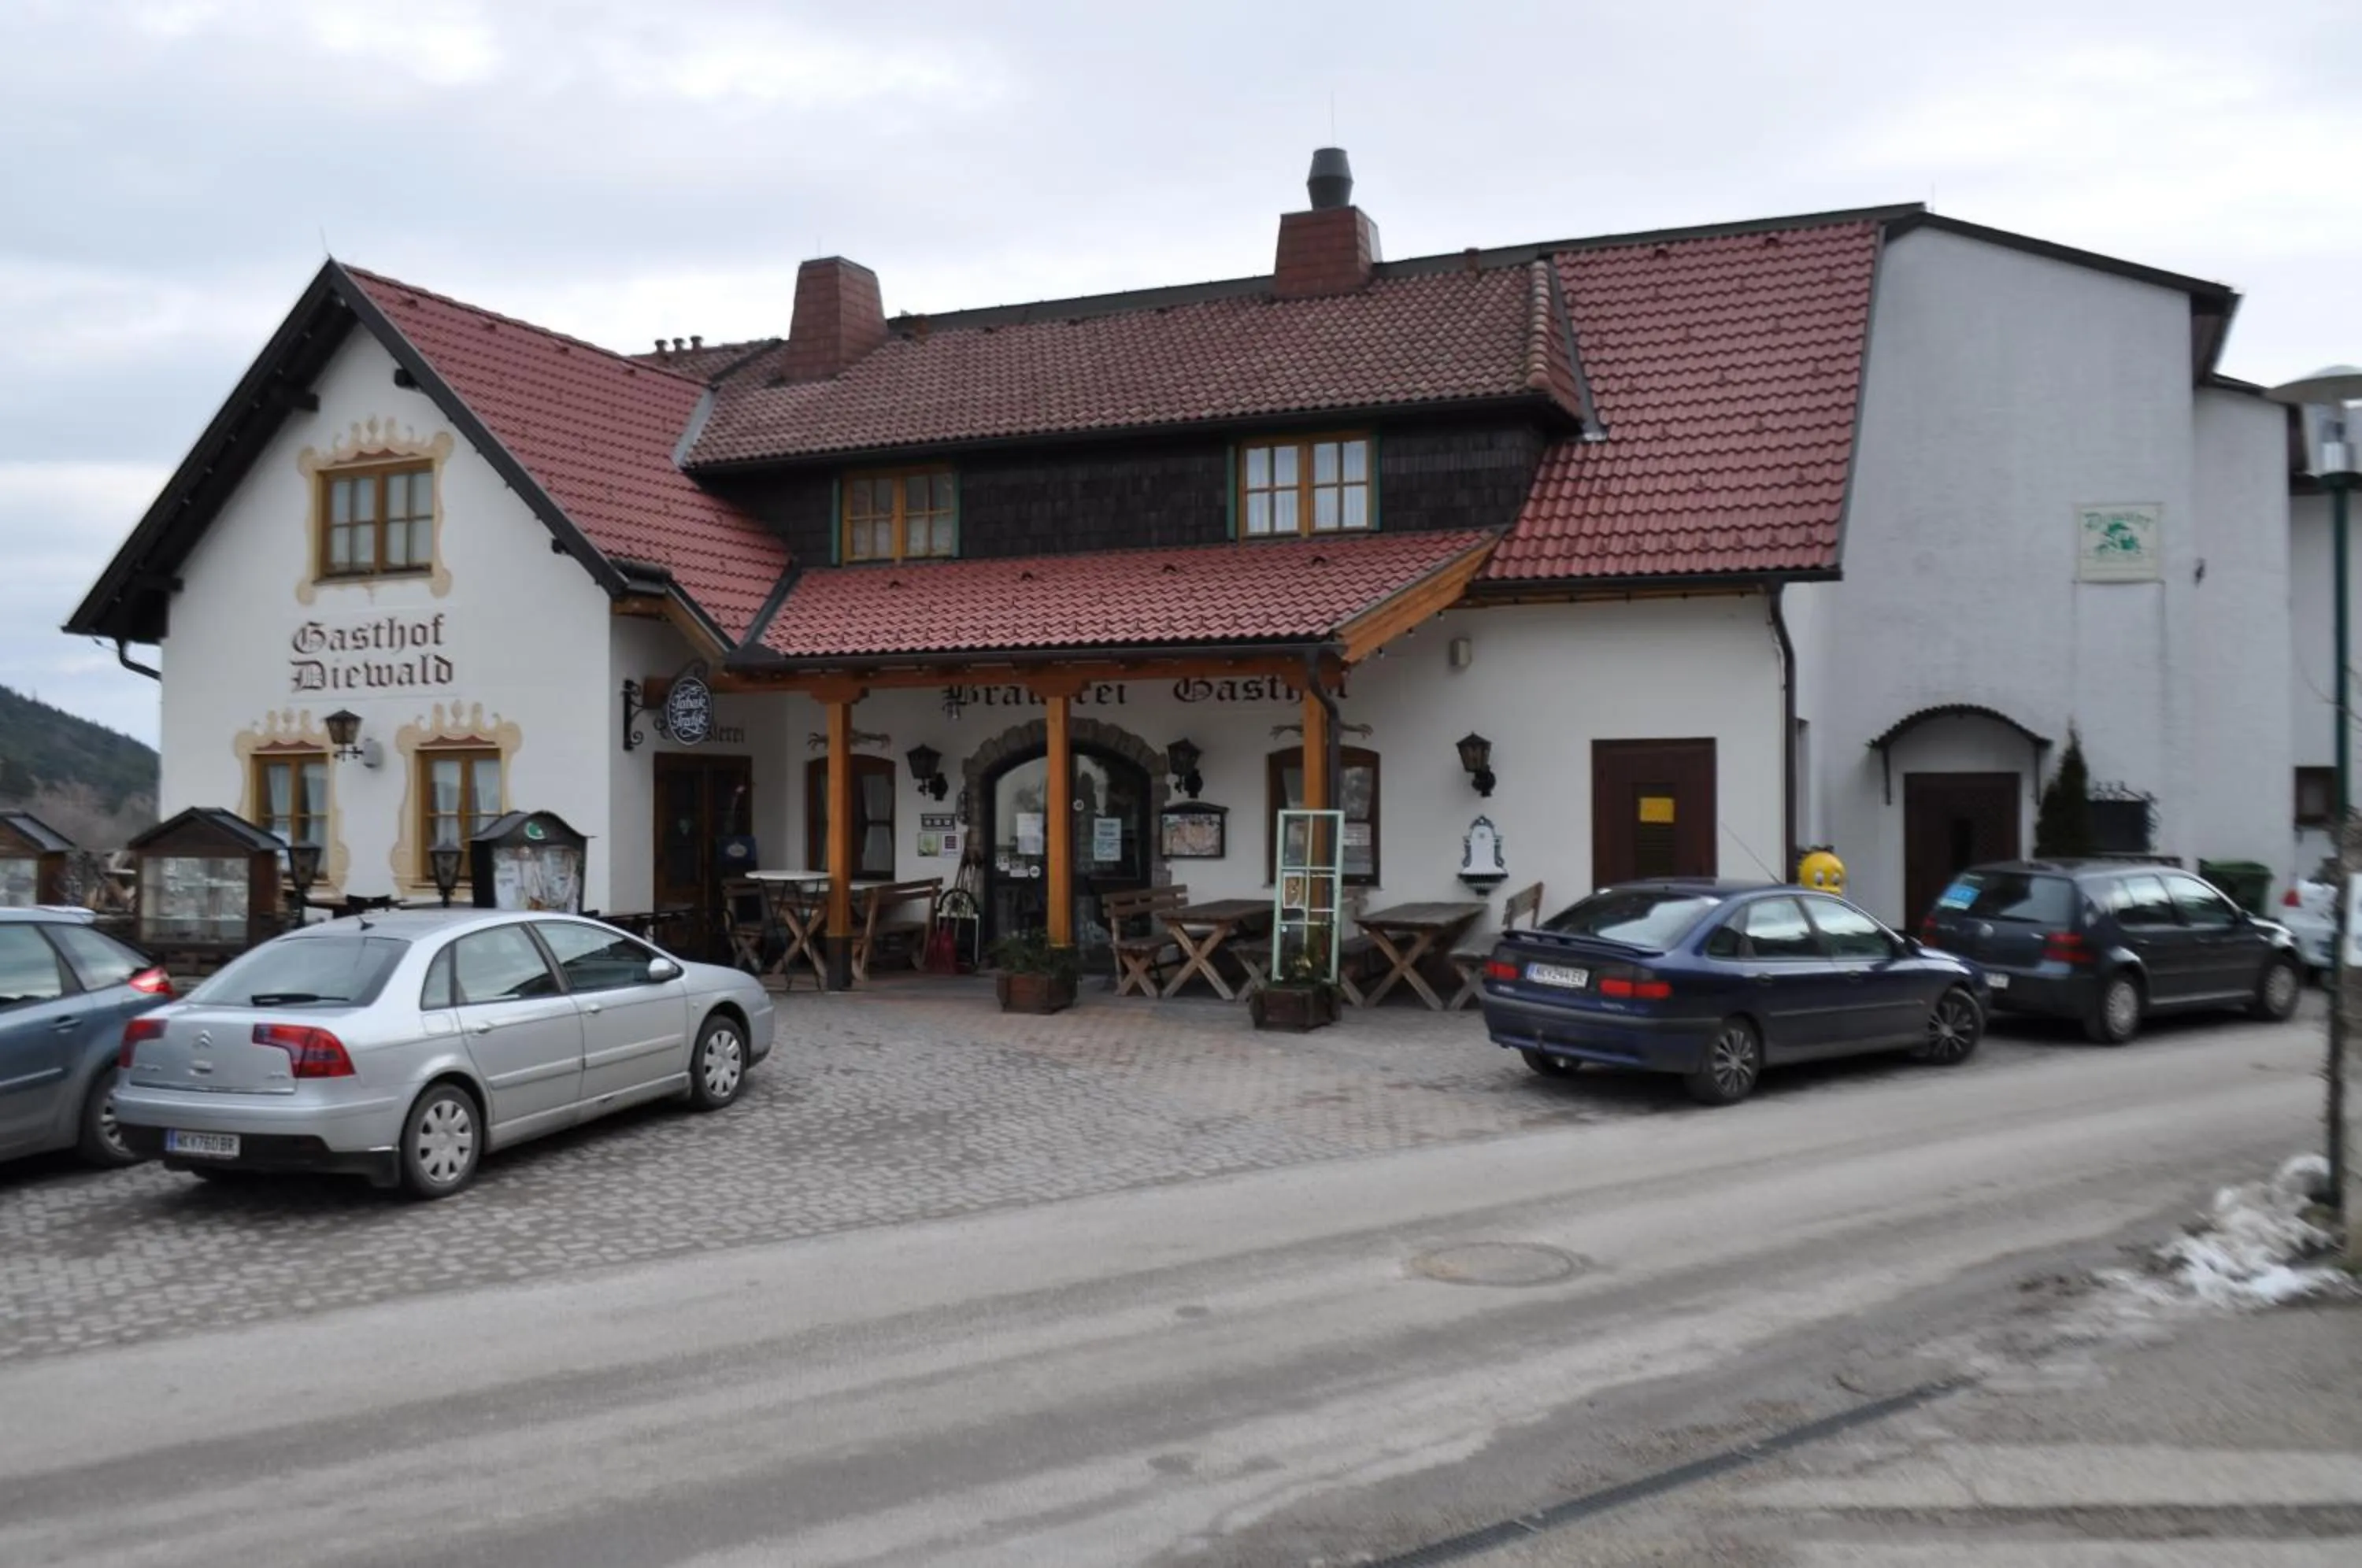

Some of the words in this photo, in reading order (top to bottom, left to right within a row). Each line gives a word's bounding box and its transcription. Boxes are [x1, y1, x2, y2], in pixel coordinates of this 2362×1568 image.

[291, 613, 445, 654] Gasthof
[289, 653, 454, 693] Diewald
[942, 682, 1127, 706] Braurei
[1172, 675, 1349, 705] Gasthf
